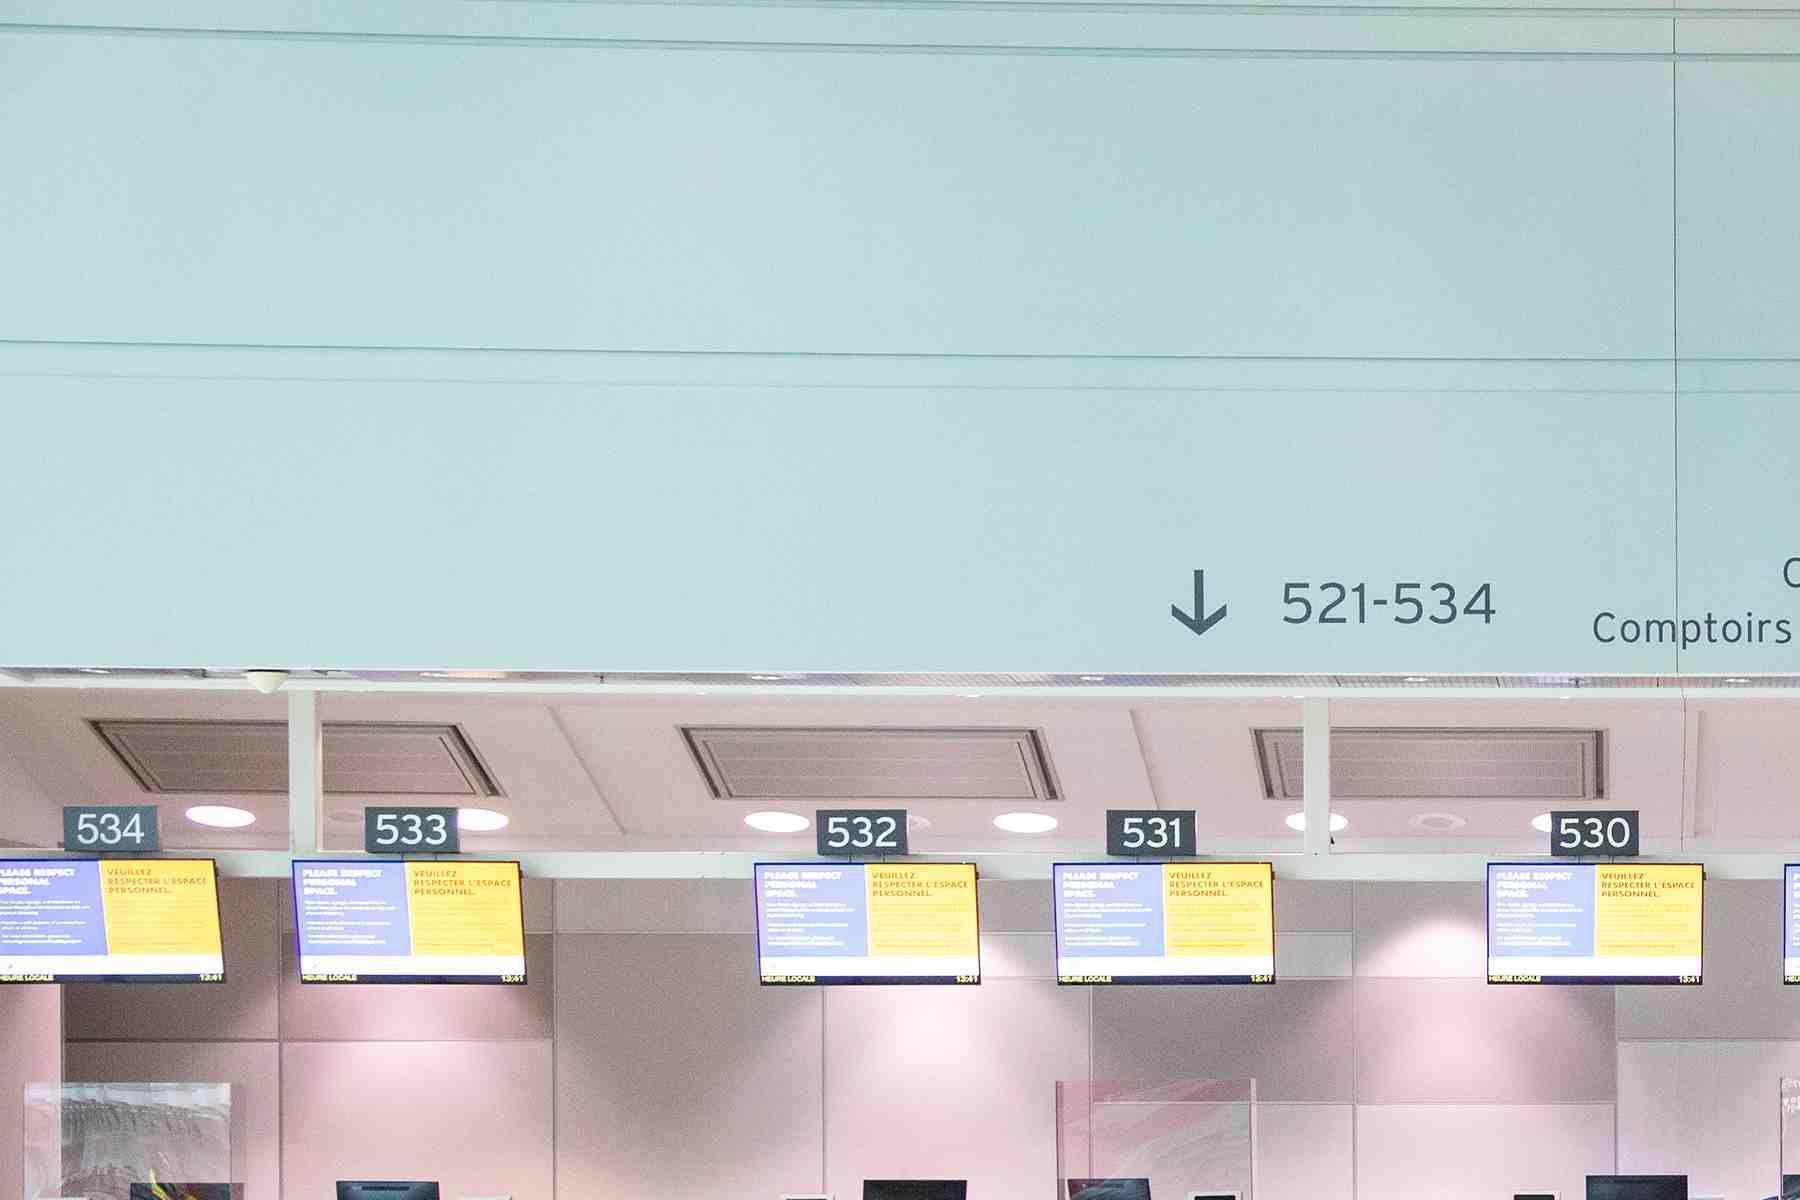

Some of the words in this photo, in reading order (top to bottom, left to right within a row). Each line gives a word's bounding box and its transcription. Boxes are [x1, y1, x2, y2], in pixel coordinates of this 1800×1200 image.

[1282, 582, 1496, 625] 521-534
[1593, 611, 1792, 650] Comptoirs
[77, 813, 145, 845] 534
[376, 814, 448, 845] 533
[827, 816, 897, 848] 532
[1122, 817, 1181, 848] 531
[1559, 817, 1631, 848] 530
